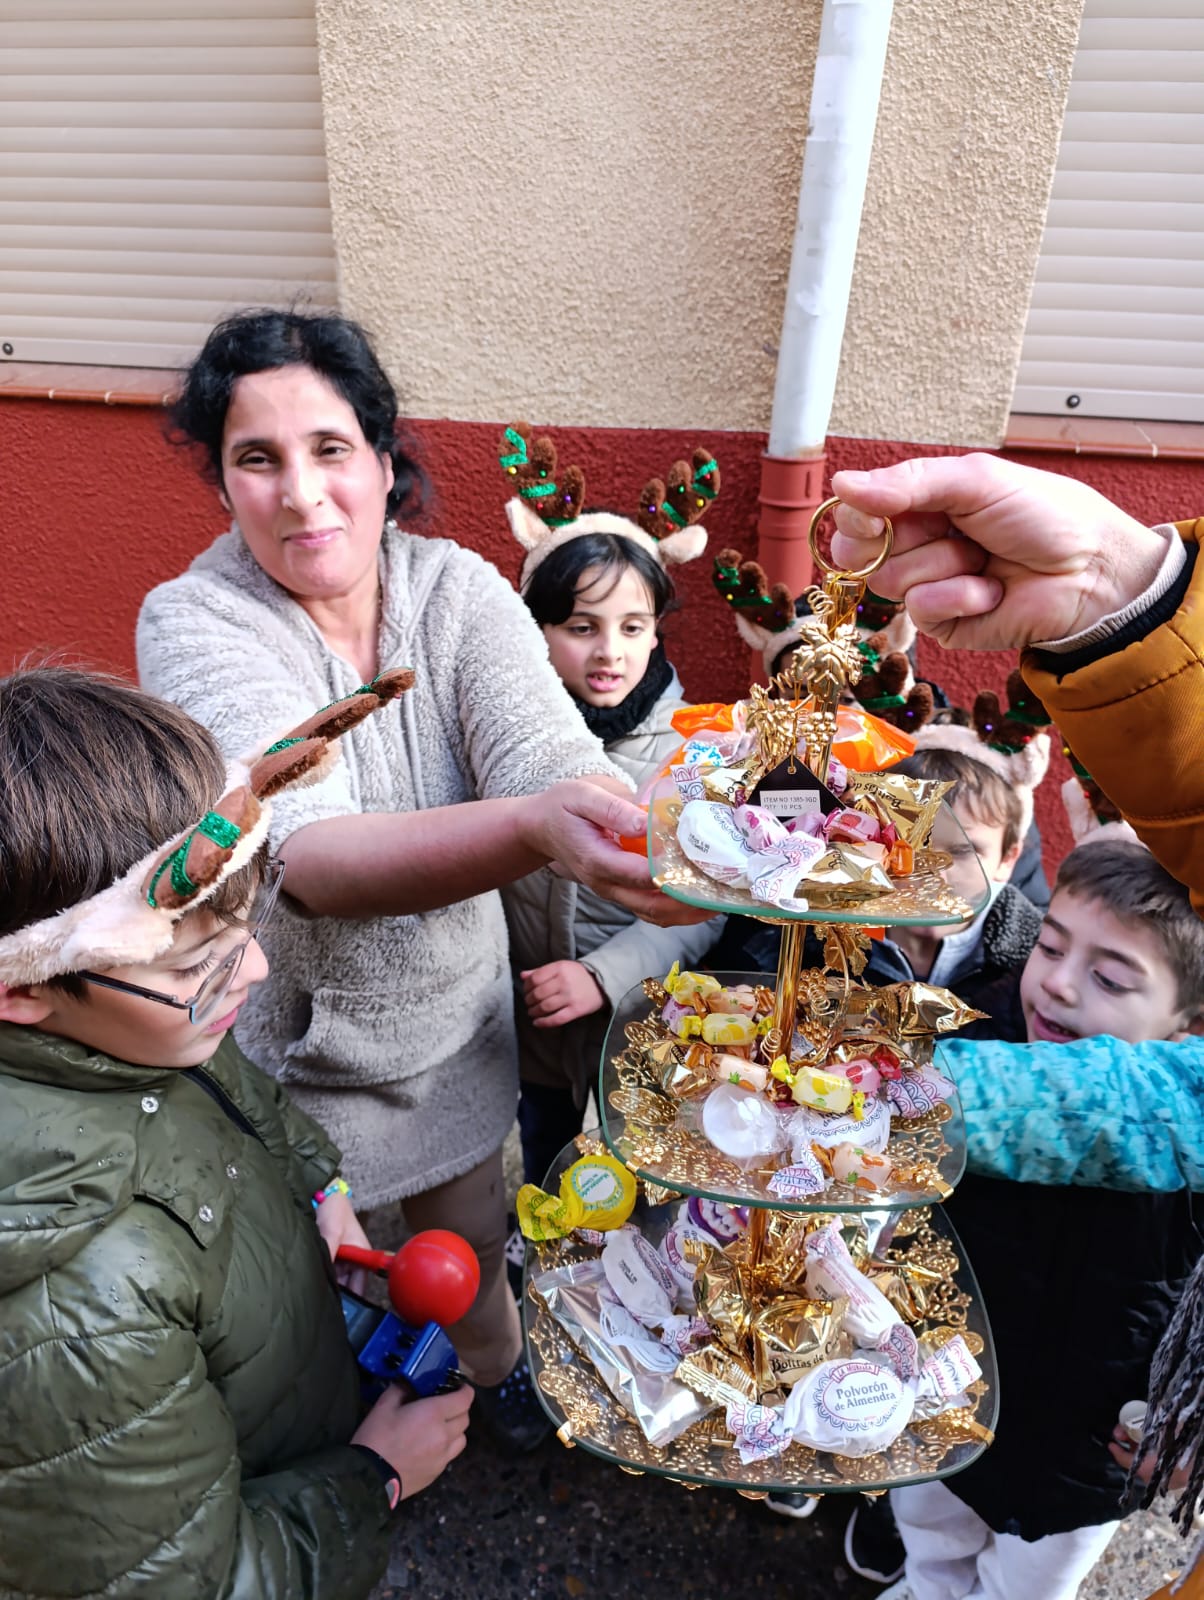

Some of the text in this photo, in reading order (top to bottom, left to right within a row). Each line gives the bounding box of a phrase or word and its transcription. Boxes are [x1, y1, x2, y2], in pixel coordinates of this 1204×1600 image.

[771, 1358, 812, 1374] Bolitas
[836, 1381, 888, 1400] Polvorón
[834, 1391, 897, 1412] de Almendra
